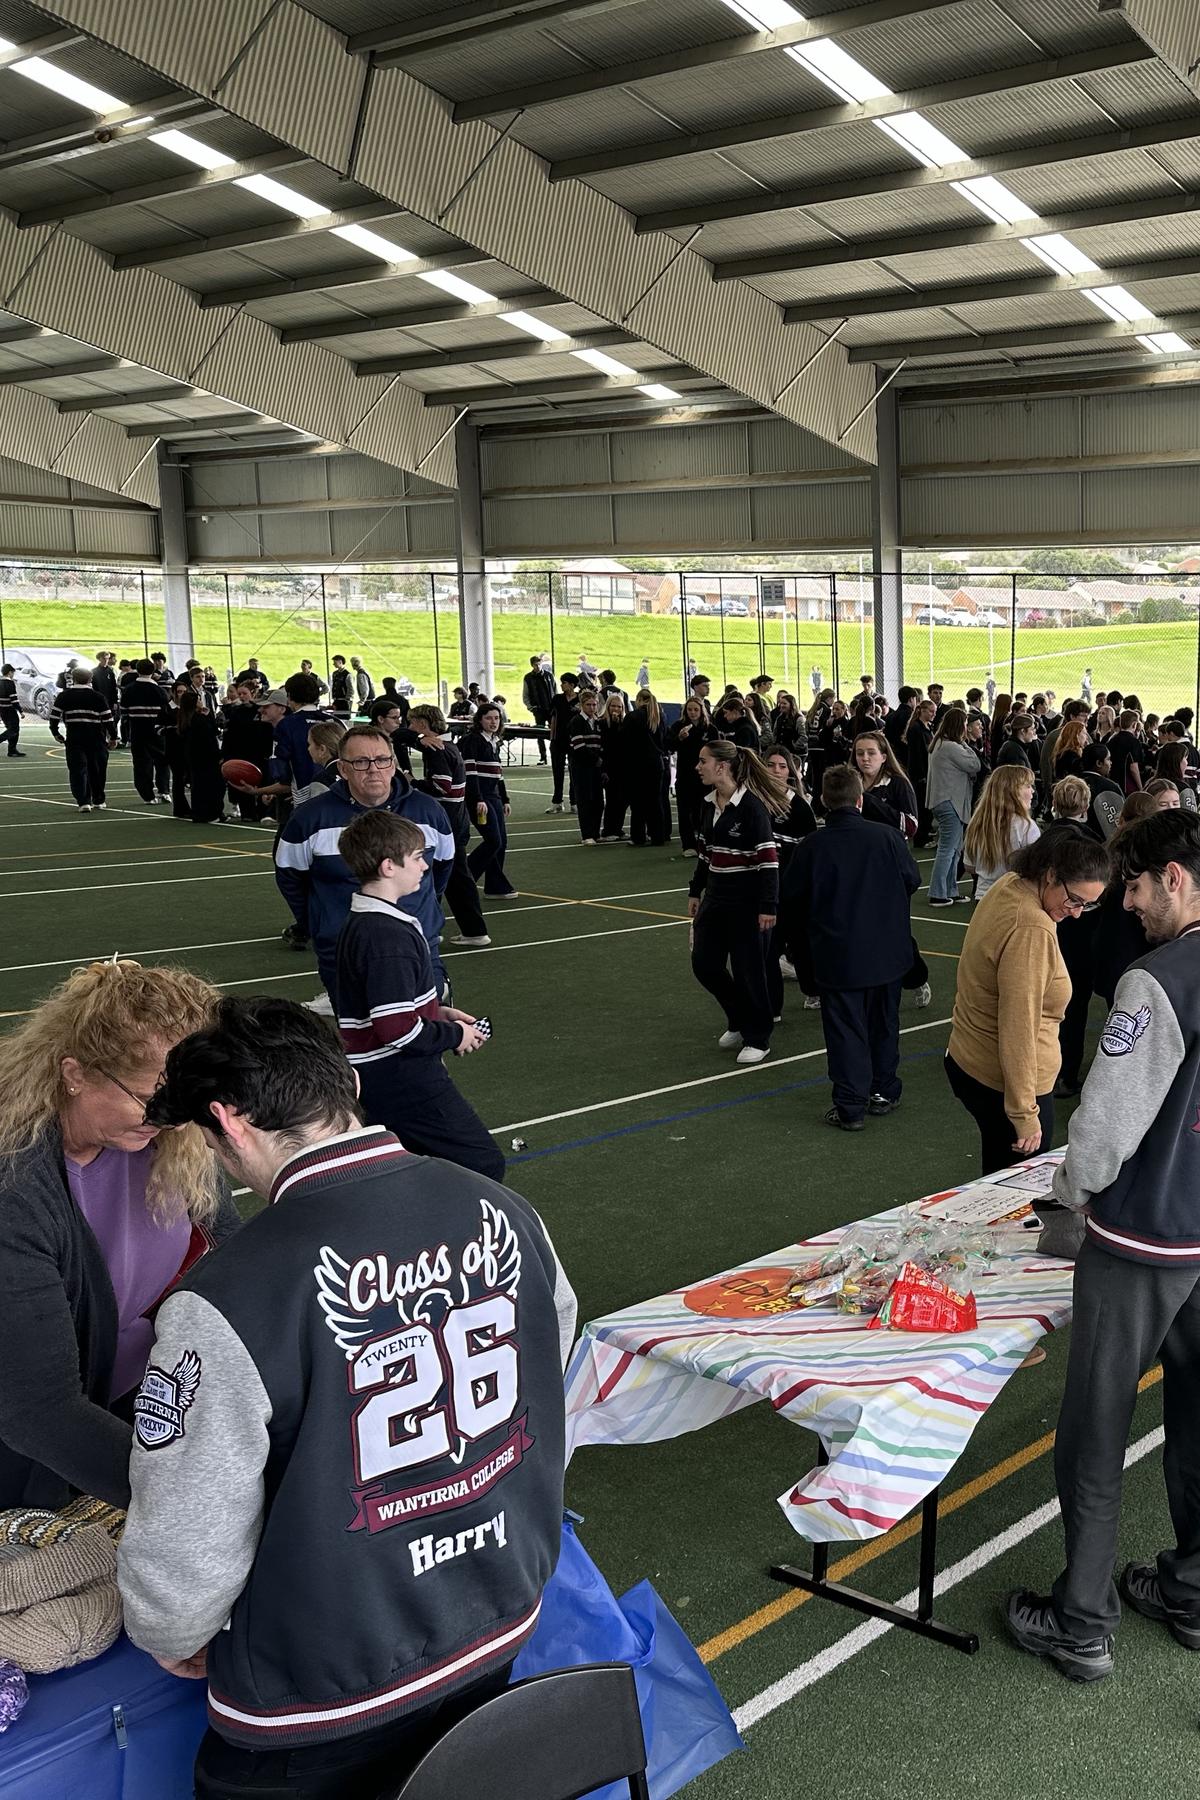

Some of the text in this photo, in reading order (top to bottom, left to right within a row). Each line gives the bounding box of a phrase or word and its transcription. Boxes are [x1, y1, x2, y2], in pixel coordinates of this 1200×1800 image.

[349, 1220, 499, 1313] Class of
[352, 1294, 519, 1482] 26
[360, 1335, 428, 1368] TWENTY
[377, 1445, 515, 1521] WANTIRNA COLLEGE
[408, 1510, 508, 1578] Harry
